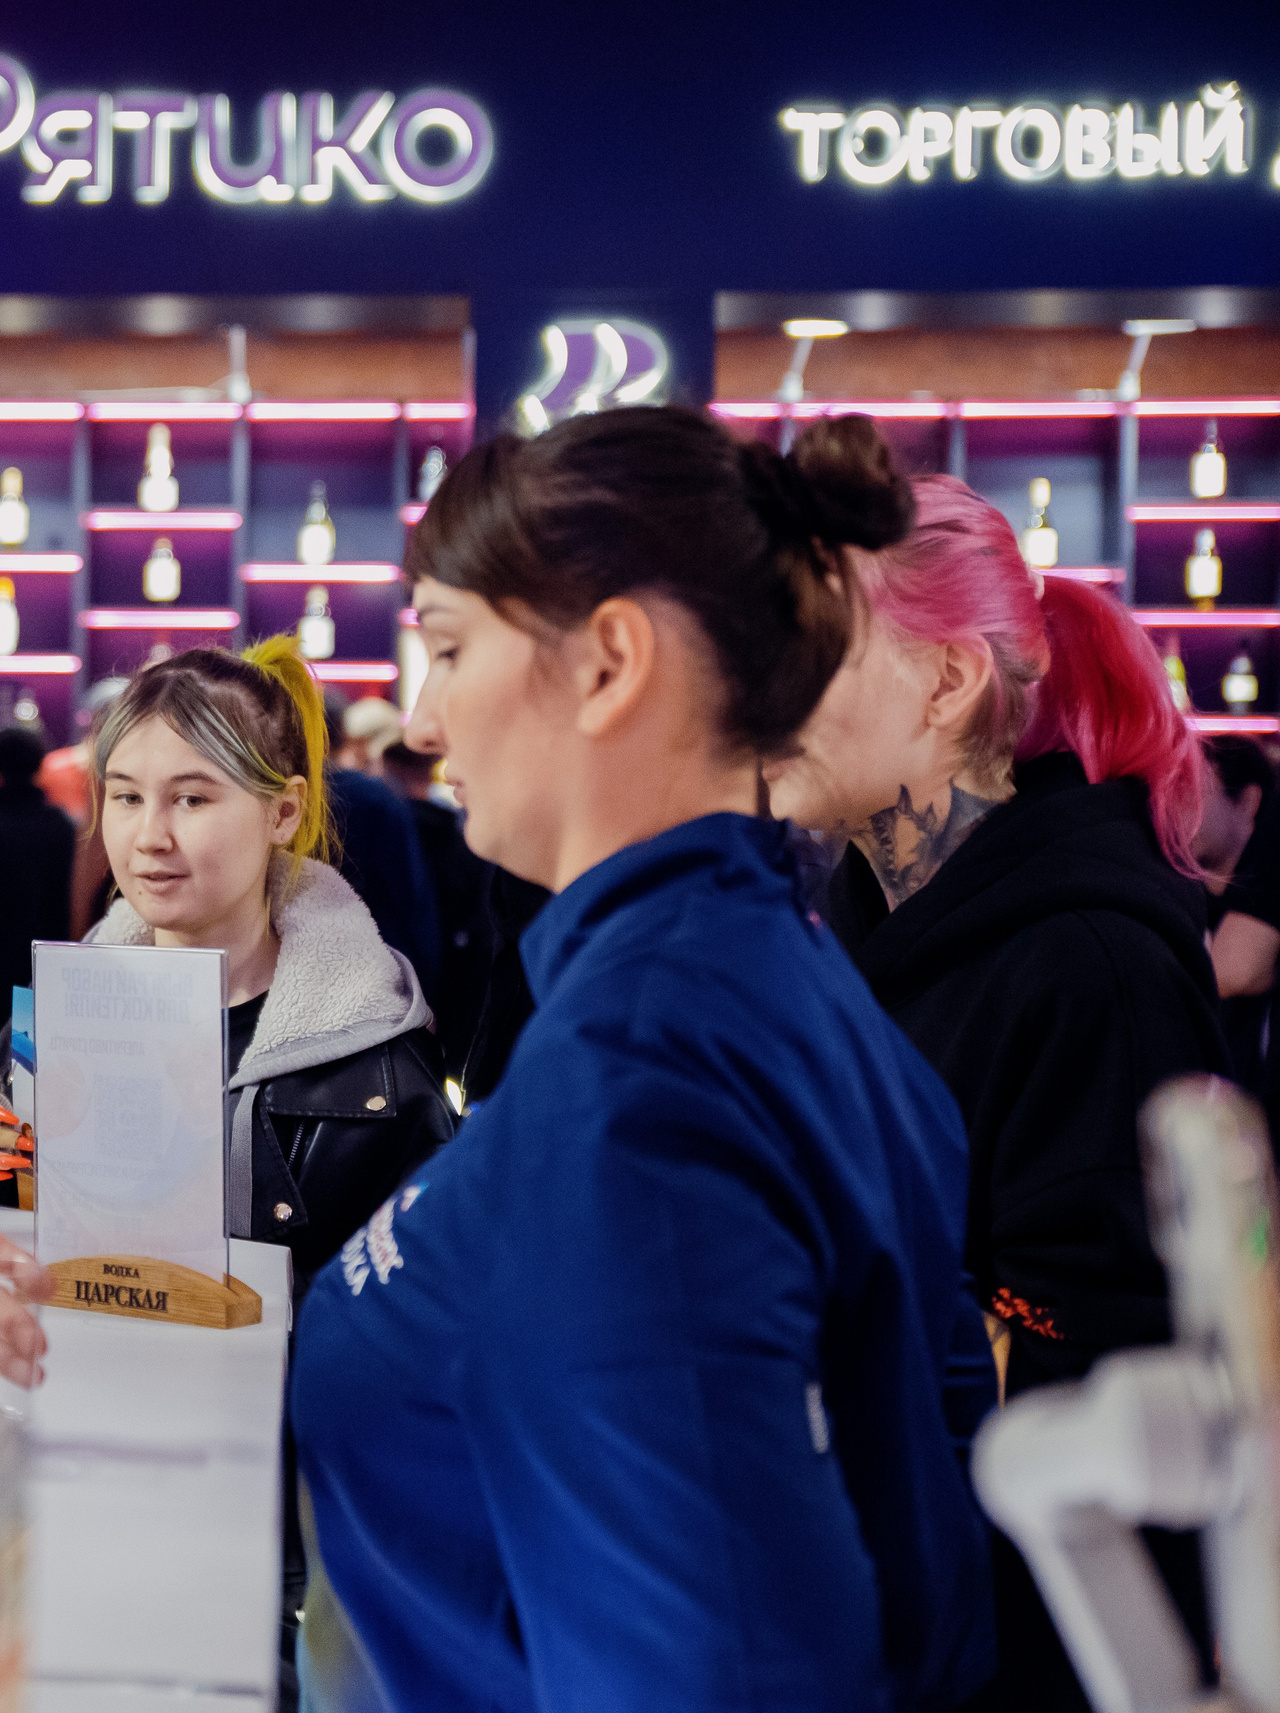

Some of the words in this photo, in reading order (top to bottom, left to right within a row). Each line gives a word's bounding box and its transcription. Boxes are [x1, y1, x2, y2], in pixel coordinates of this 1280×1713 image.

[778, 80, 1252, 187] ТОРГОВЫЙ
[102, 1263, 140, 1279] ВОДКА
[74, 1280, 170, 1314] ЦАРСКАЯ
